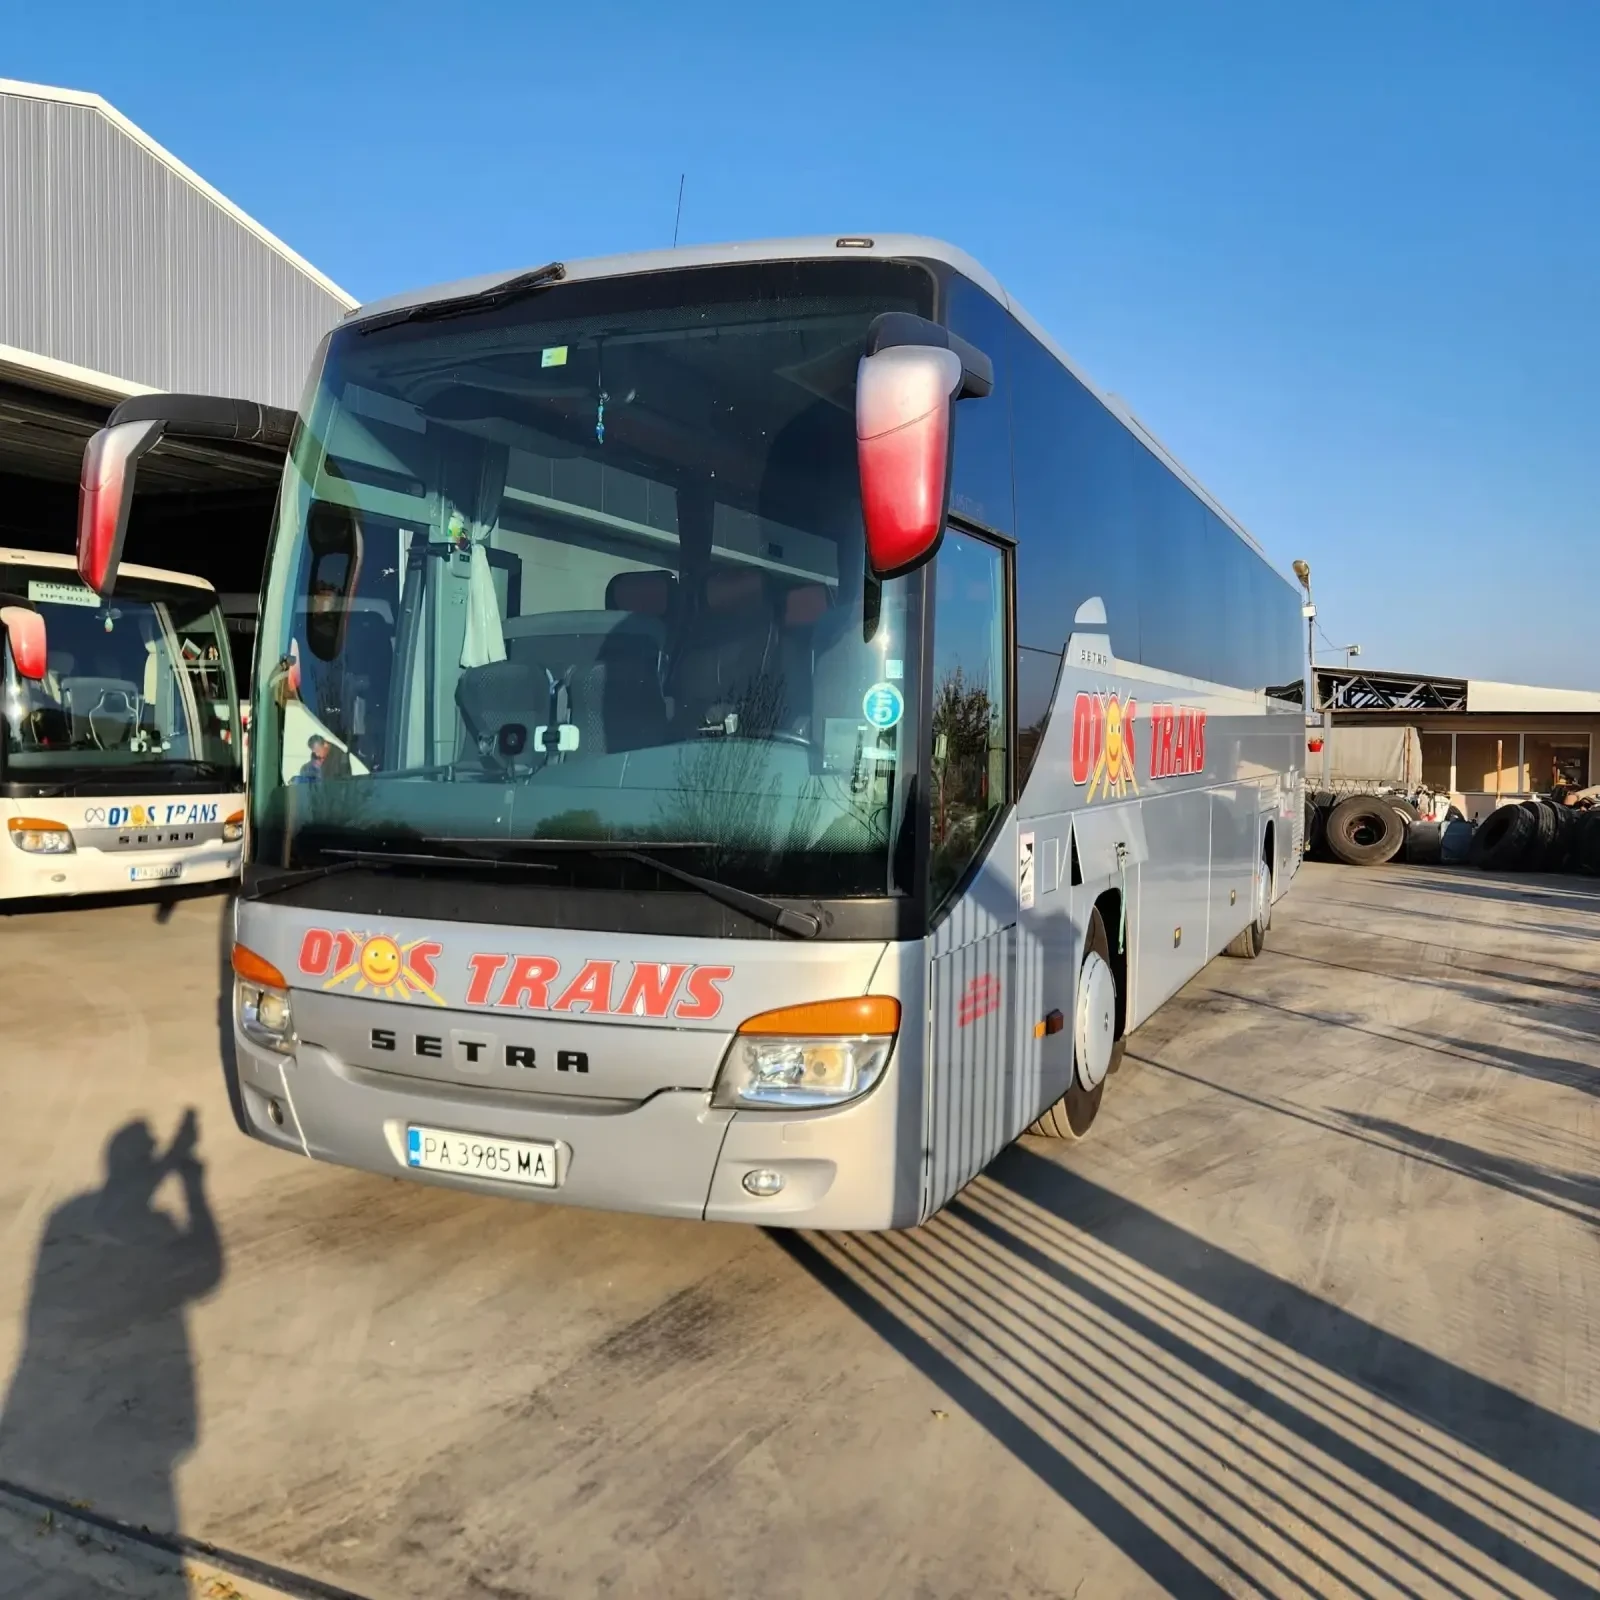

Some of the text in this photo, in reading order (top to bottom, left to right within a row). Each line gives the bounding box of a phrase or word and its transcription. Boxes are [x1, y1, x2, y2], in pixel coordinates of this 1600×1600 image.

[1081, 649, 1107, 666] SETRA
[1150, 702, 1207, 780] TRANS
[466, 952, 735, 1020] TRANS
[370, 1028, 590, 1074] SETRA
[424, 1137, 547, 1178] PA 3985 MA
